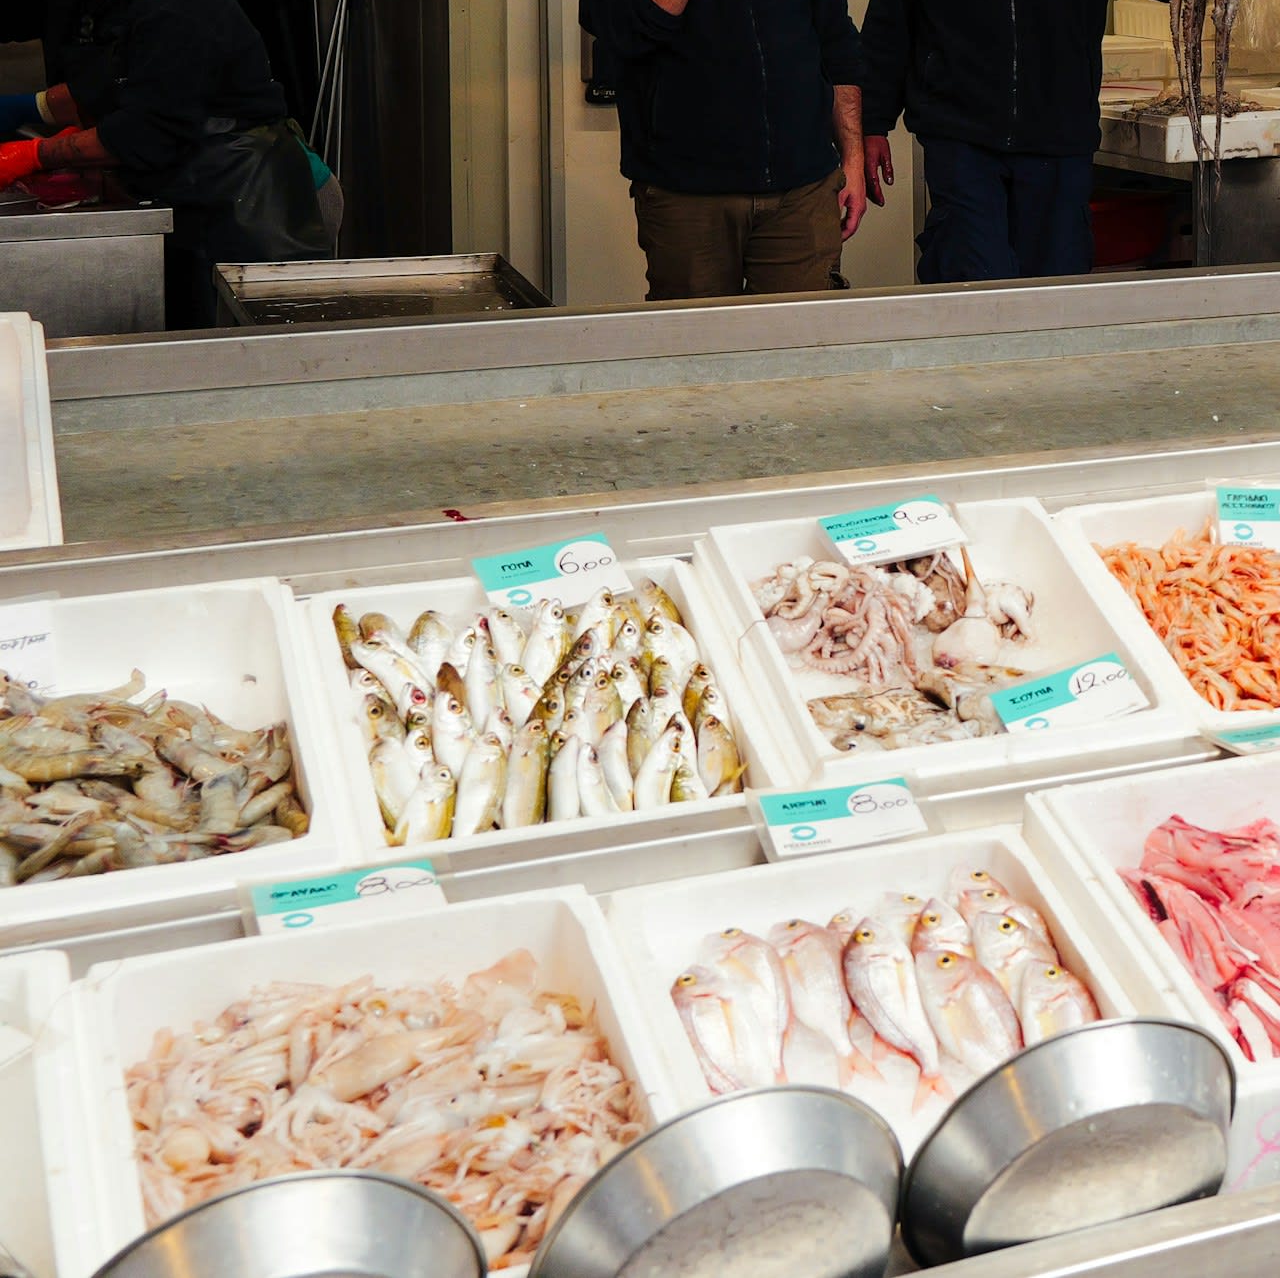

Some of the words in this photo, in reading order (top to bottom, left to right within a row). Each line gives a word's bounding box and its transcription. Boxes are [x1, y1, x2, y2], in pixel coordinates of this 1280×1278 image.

[559, 551, 612, 574] 6,00
[1074, 669, 1128, 695] 12,00
[850, 794, 908, 814] 8,00
